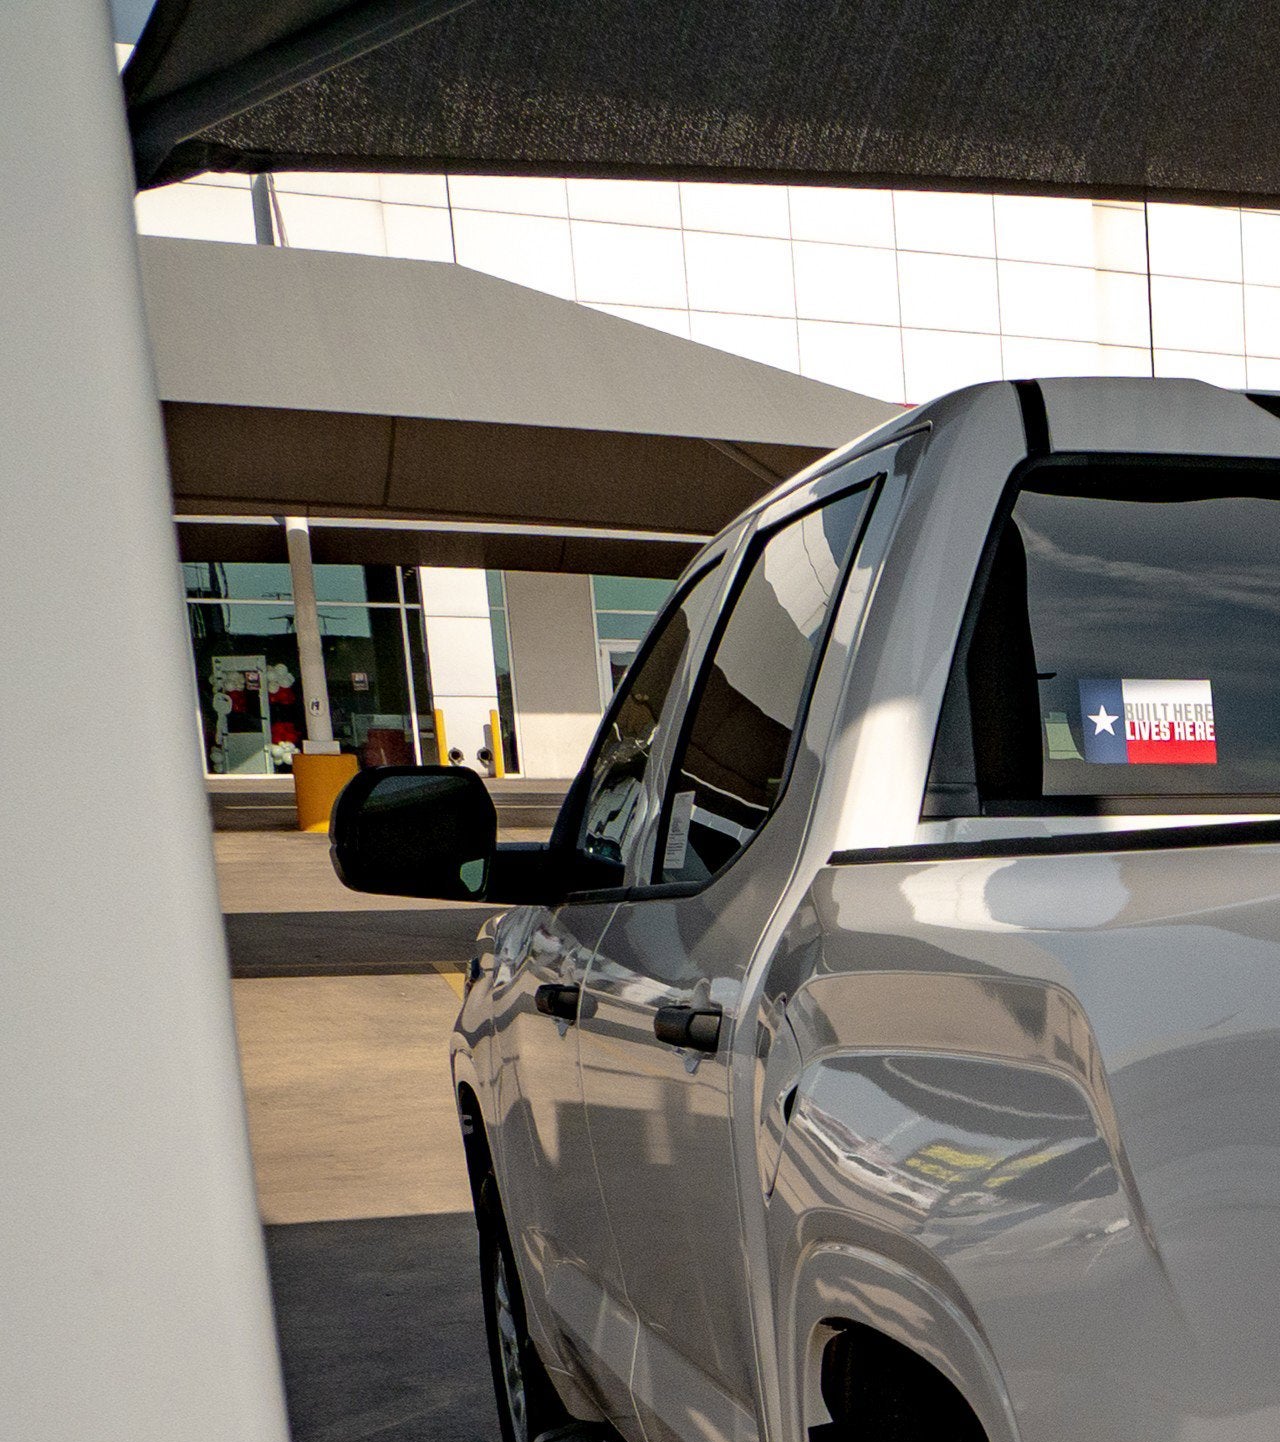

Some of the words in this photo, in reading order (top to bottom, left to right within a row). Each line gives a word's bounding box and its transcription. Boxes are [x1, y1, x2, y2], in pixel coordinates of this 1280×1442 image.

[1125, 702, 1169, 722] BUILT
[1173, 702, 1213, 722] HERE
[1125, 721, 1171, 741] LIVES
[1173, 721, 1216, 741] HERE
